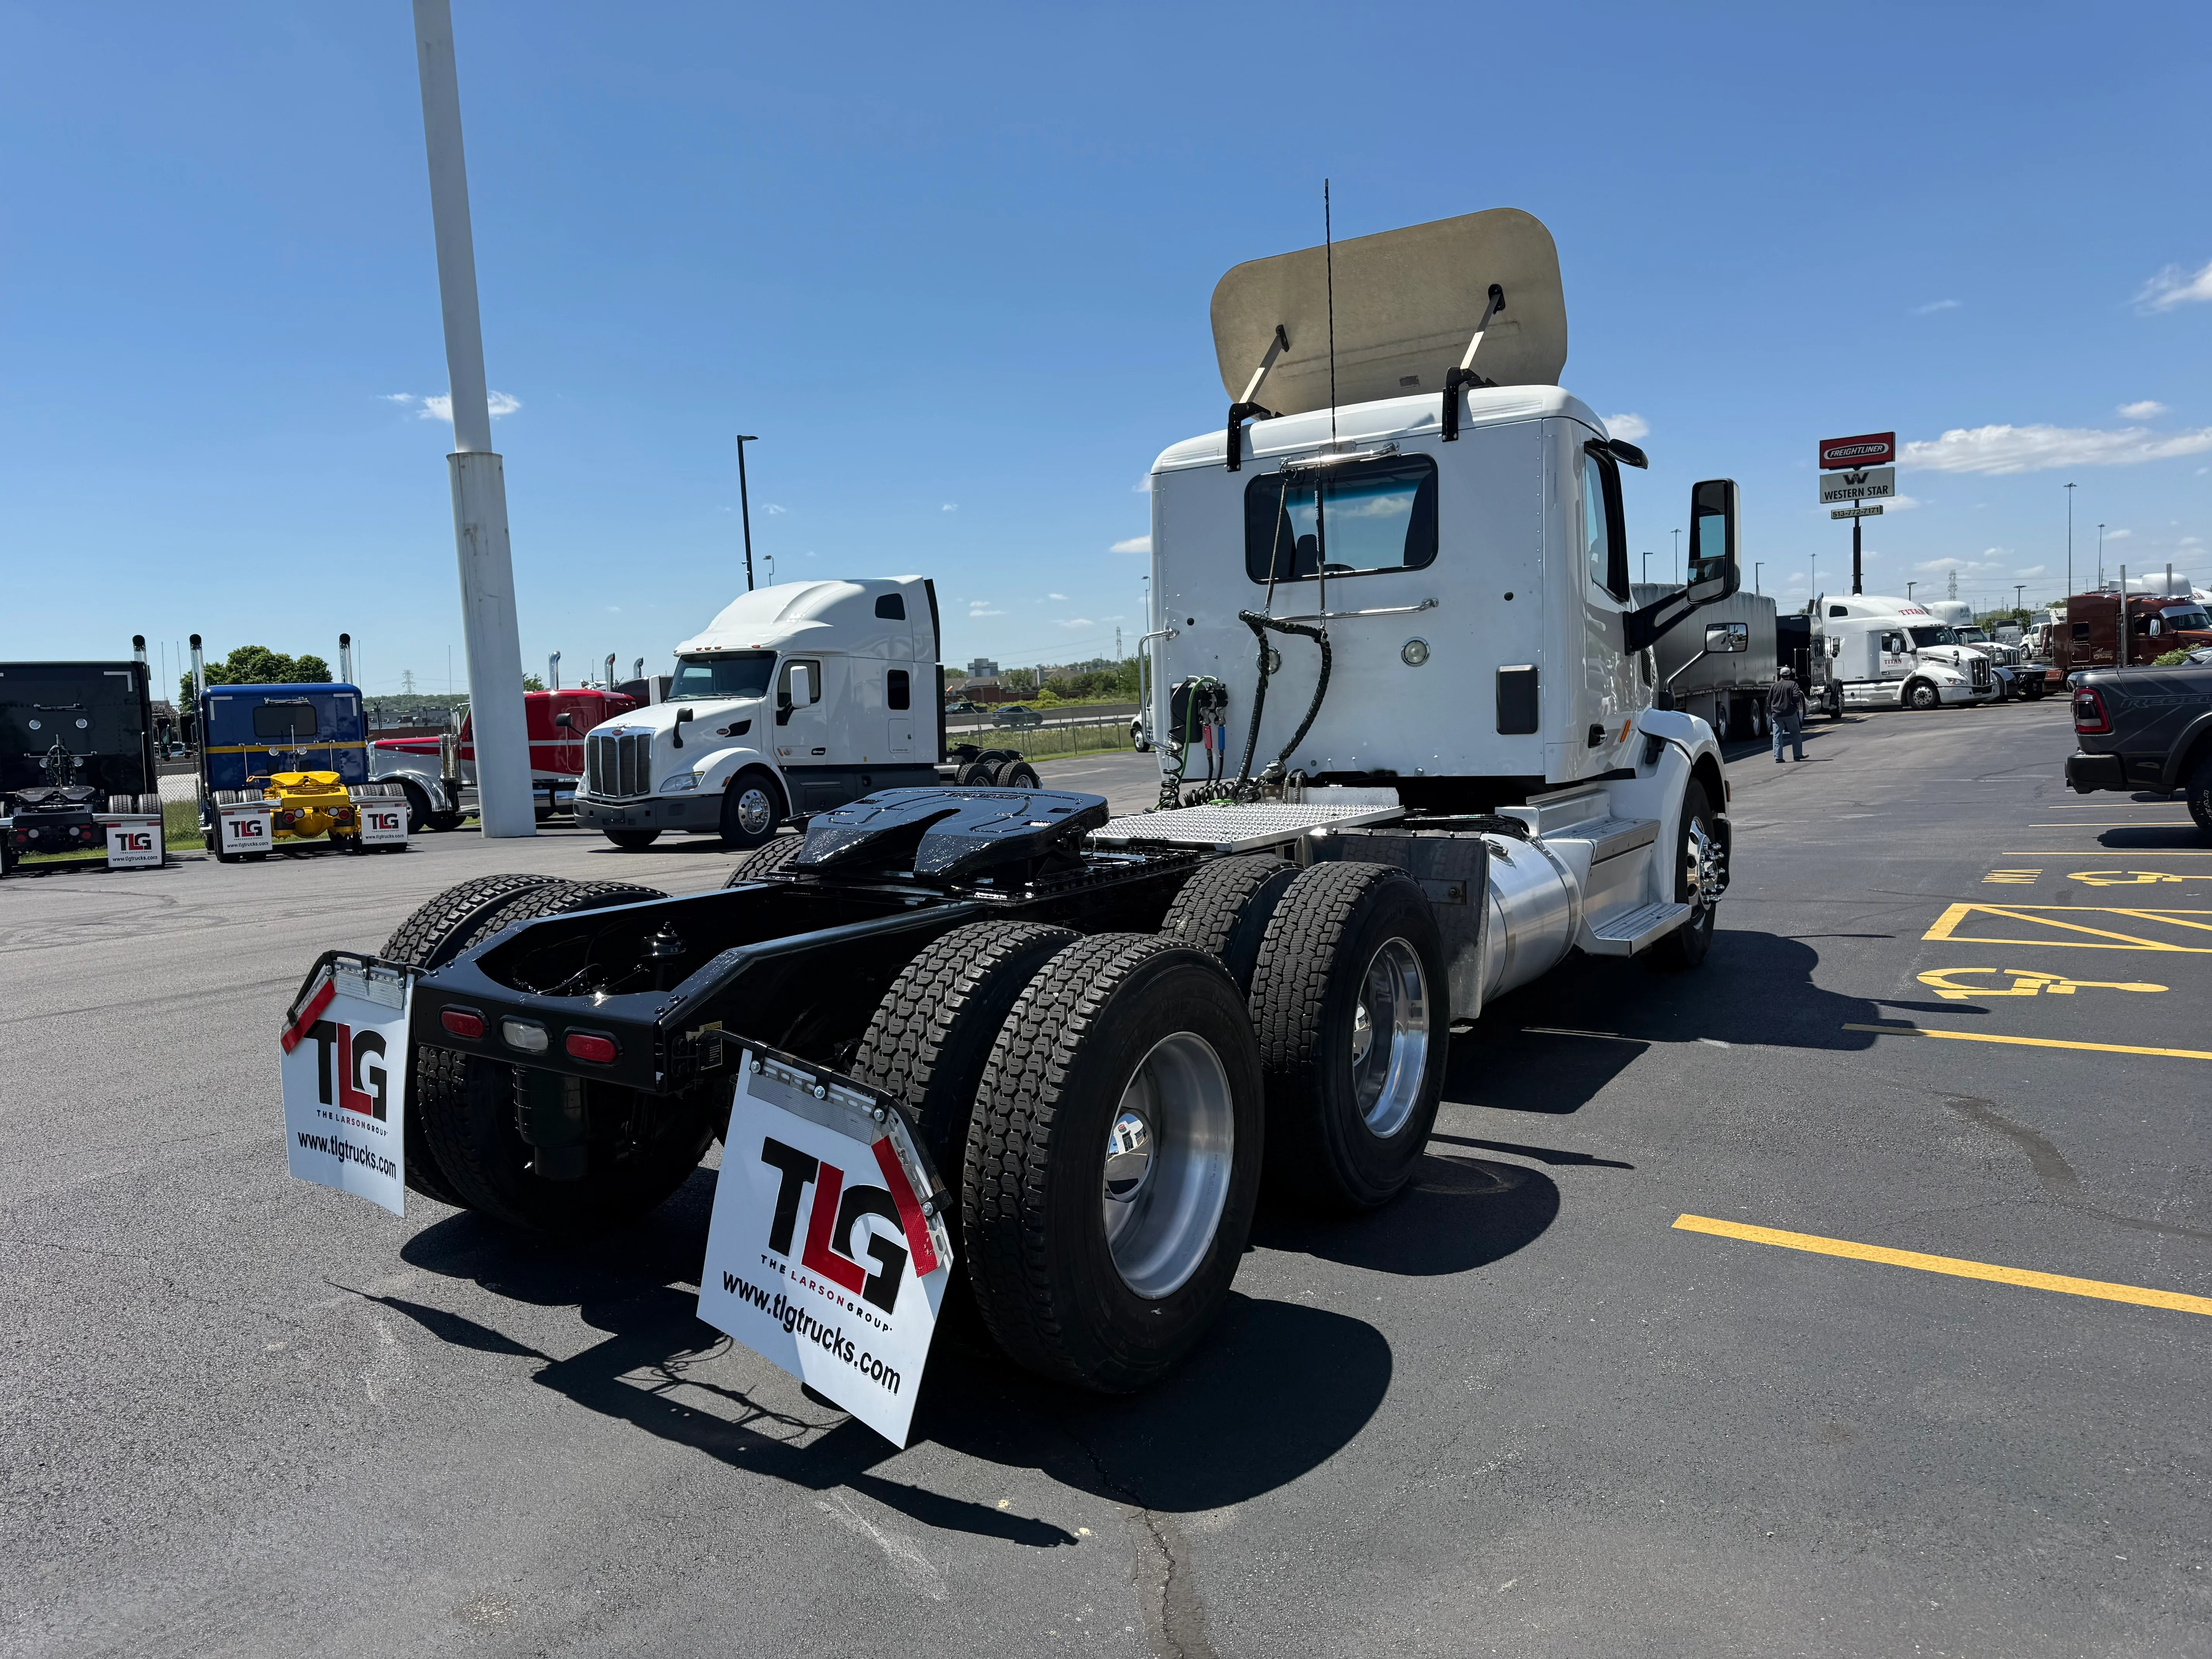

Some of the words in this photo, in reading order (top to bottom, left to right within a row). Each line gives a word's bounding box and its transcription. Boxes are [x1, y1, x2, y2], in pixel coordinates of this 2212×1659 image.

[1830, 445, 1883, 457] FREIGHTLINER
[1824, 488, 1864, 500] WESTERN
[1868, 485, 1888, 496] STAR
[1832, 507, 1879, 517] 513-772-7171
[228, 820, 263, 838] TLG
[368, 813, 399, 830] TLG
[115, 833, 152, 851] TLG
[303, 1019, 387, 1123] TLG
[317, 1109, 333, 1120] THE
[298, 1131, 396, 1180] www.tlgtrucks.com
[761, 1136, 908, 1316] TLG
[761, 1254, 786, 1274] THE
[723, 1270, 901, 1395] www.tlgtrucks.com
